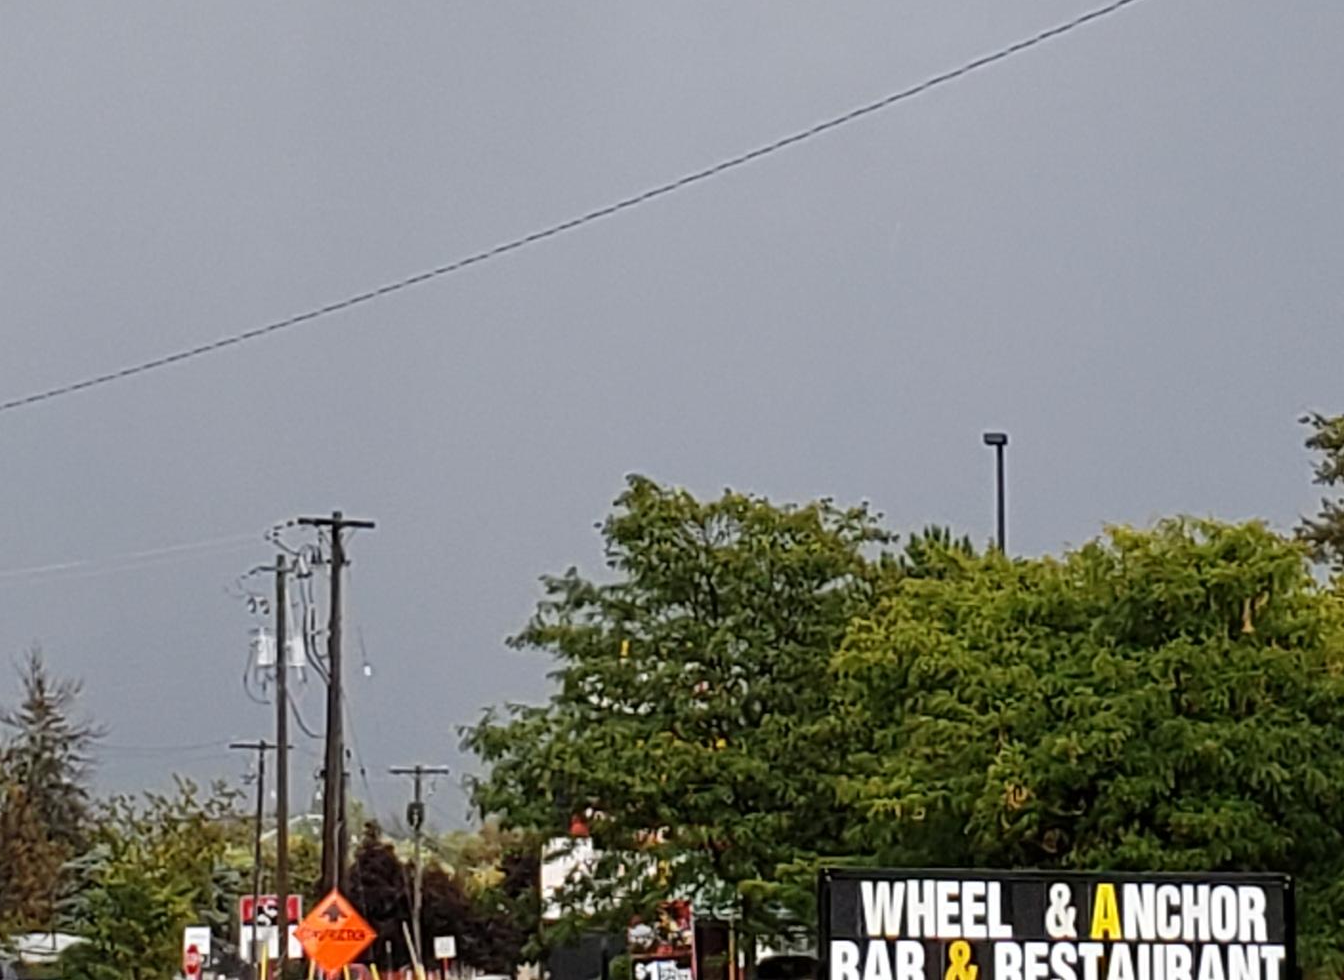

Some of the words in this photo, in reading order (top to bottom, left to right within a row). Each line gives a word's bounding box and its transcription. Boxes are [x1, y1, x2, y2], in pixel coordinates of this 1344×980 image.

[861, 880, 1012, 938] WHEEL
[1045, 882, 1077, 937] &
[1090, 883, 1268, 942] ANCHOR
[830, 940, 925, 980] BAR
[945, 941, 978, 980] &
[994, 943, 1286, 980] RESTAURANT
